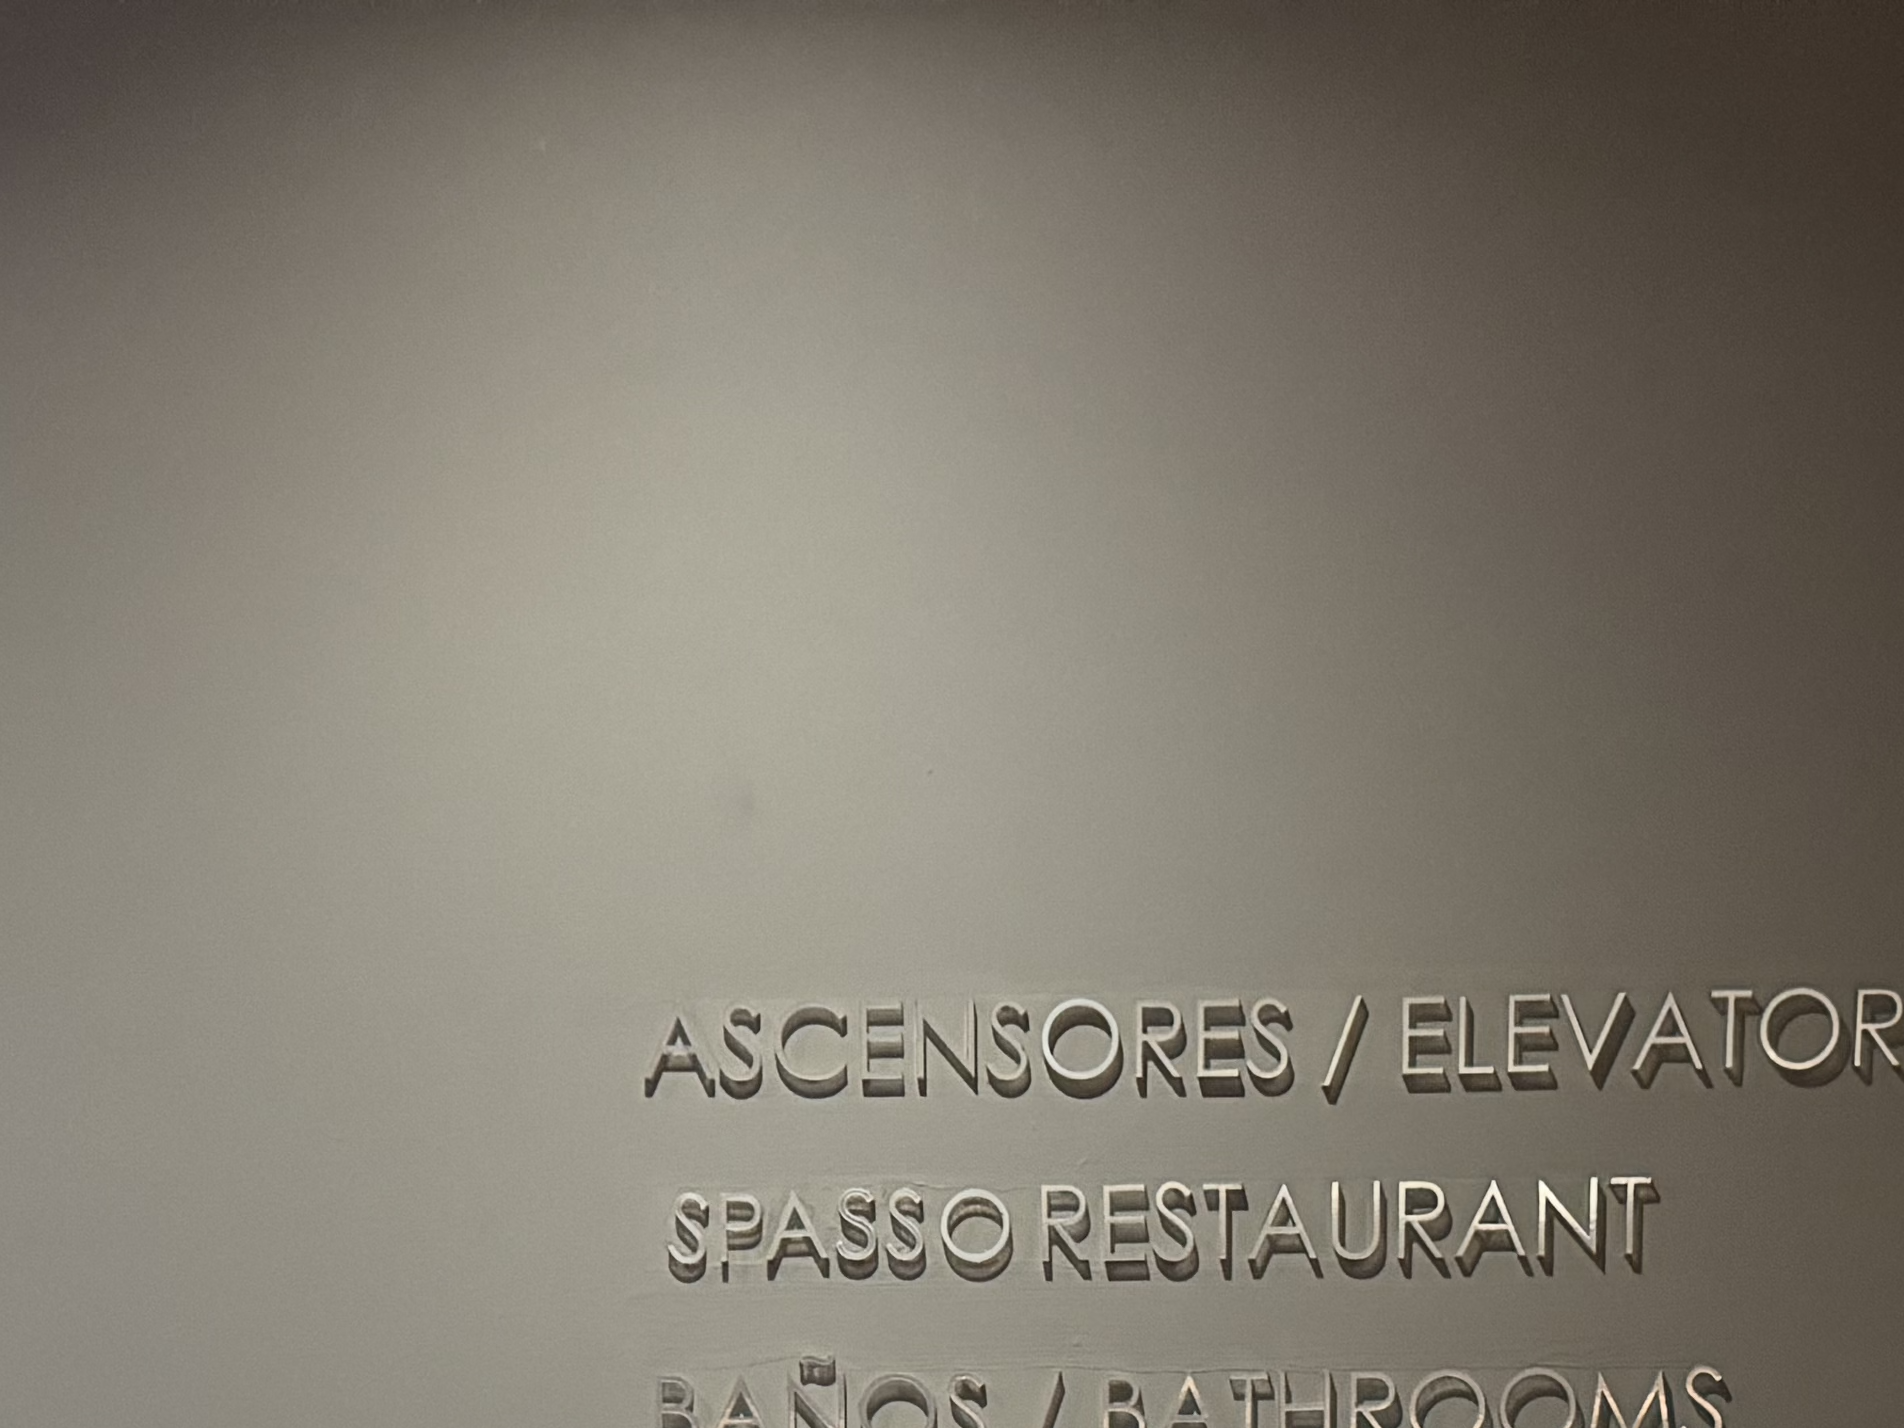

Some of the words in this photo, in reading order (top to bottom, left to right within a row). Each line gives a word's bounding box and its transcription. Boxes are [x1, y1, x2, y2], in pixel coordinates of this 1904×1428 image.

[644, 996, 1294, 1098] ASCENSORES
[666, 1185, 1014, 1283] SPASSO
[1040, 1176, 1661, 1282] RESTAURANT
